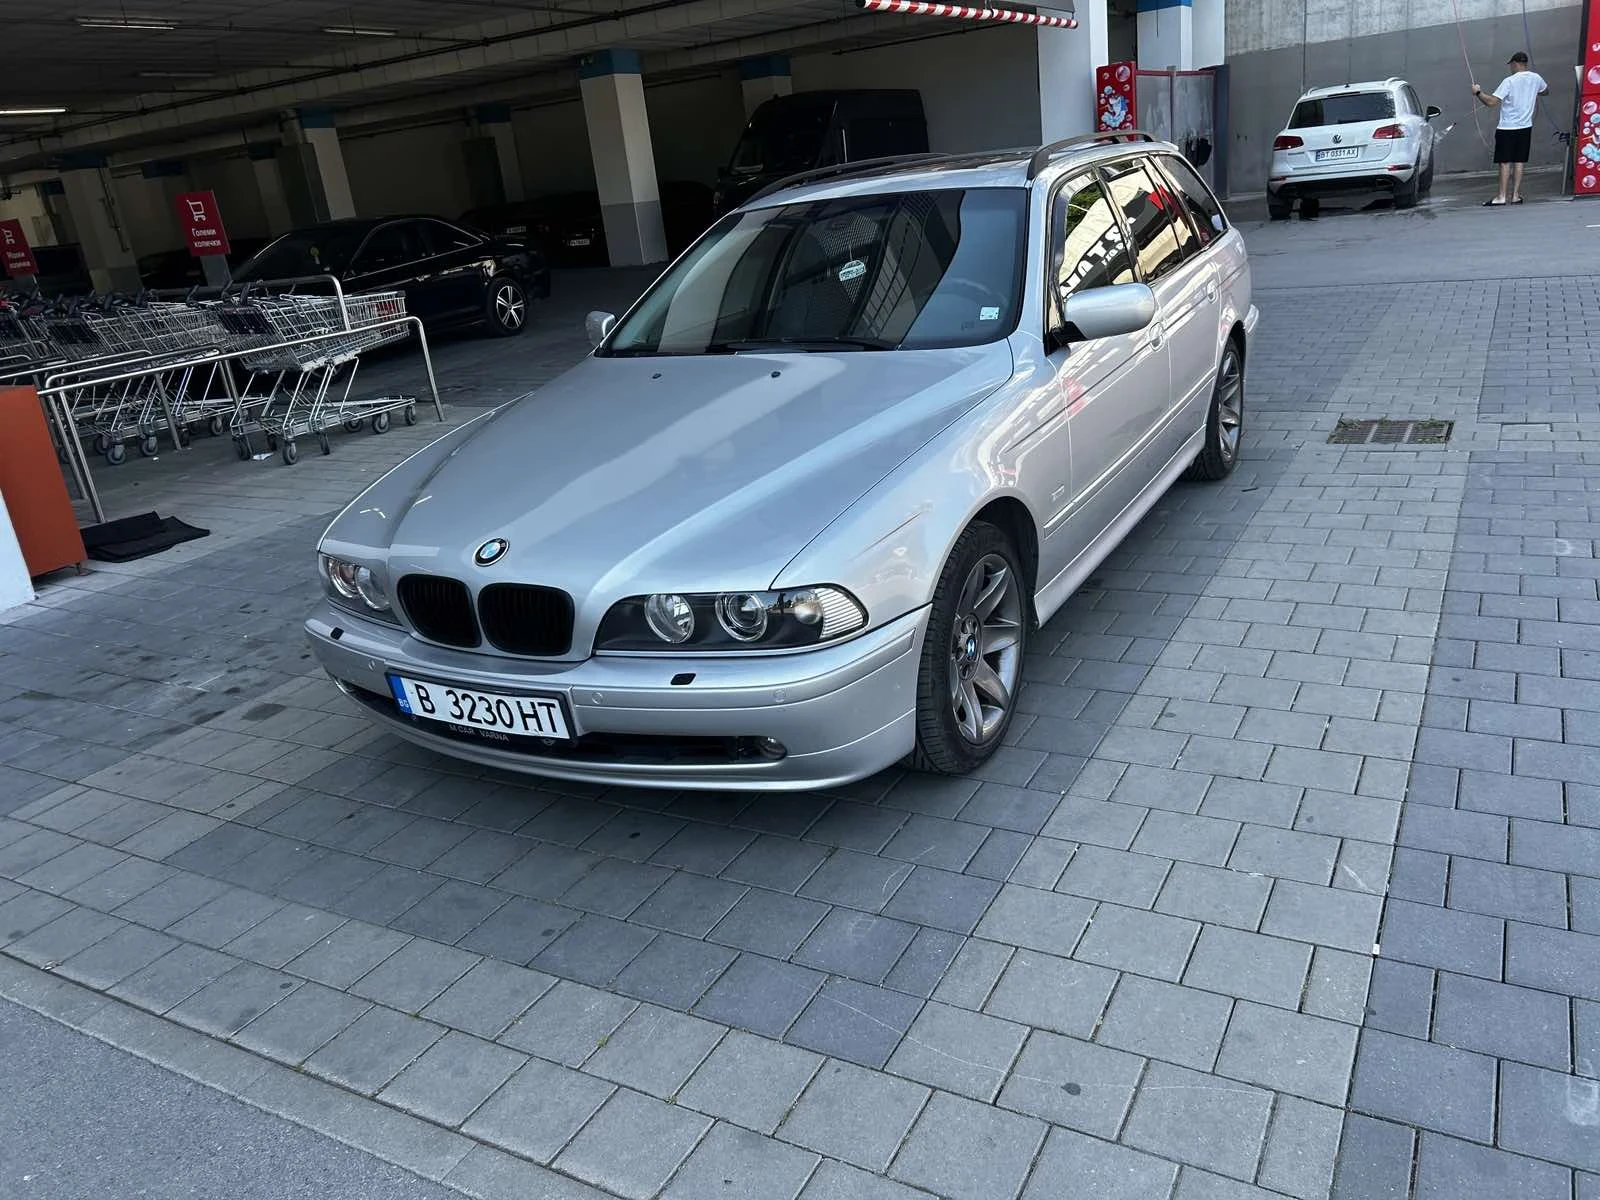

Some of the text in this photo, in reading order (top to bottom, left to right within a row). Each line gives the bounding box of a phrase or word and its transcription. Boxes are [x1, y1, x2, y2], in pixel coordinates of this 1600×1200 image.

[414, 683, 558, 734] B 3230 HT
[479, 729, 510, 742] VARNA
